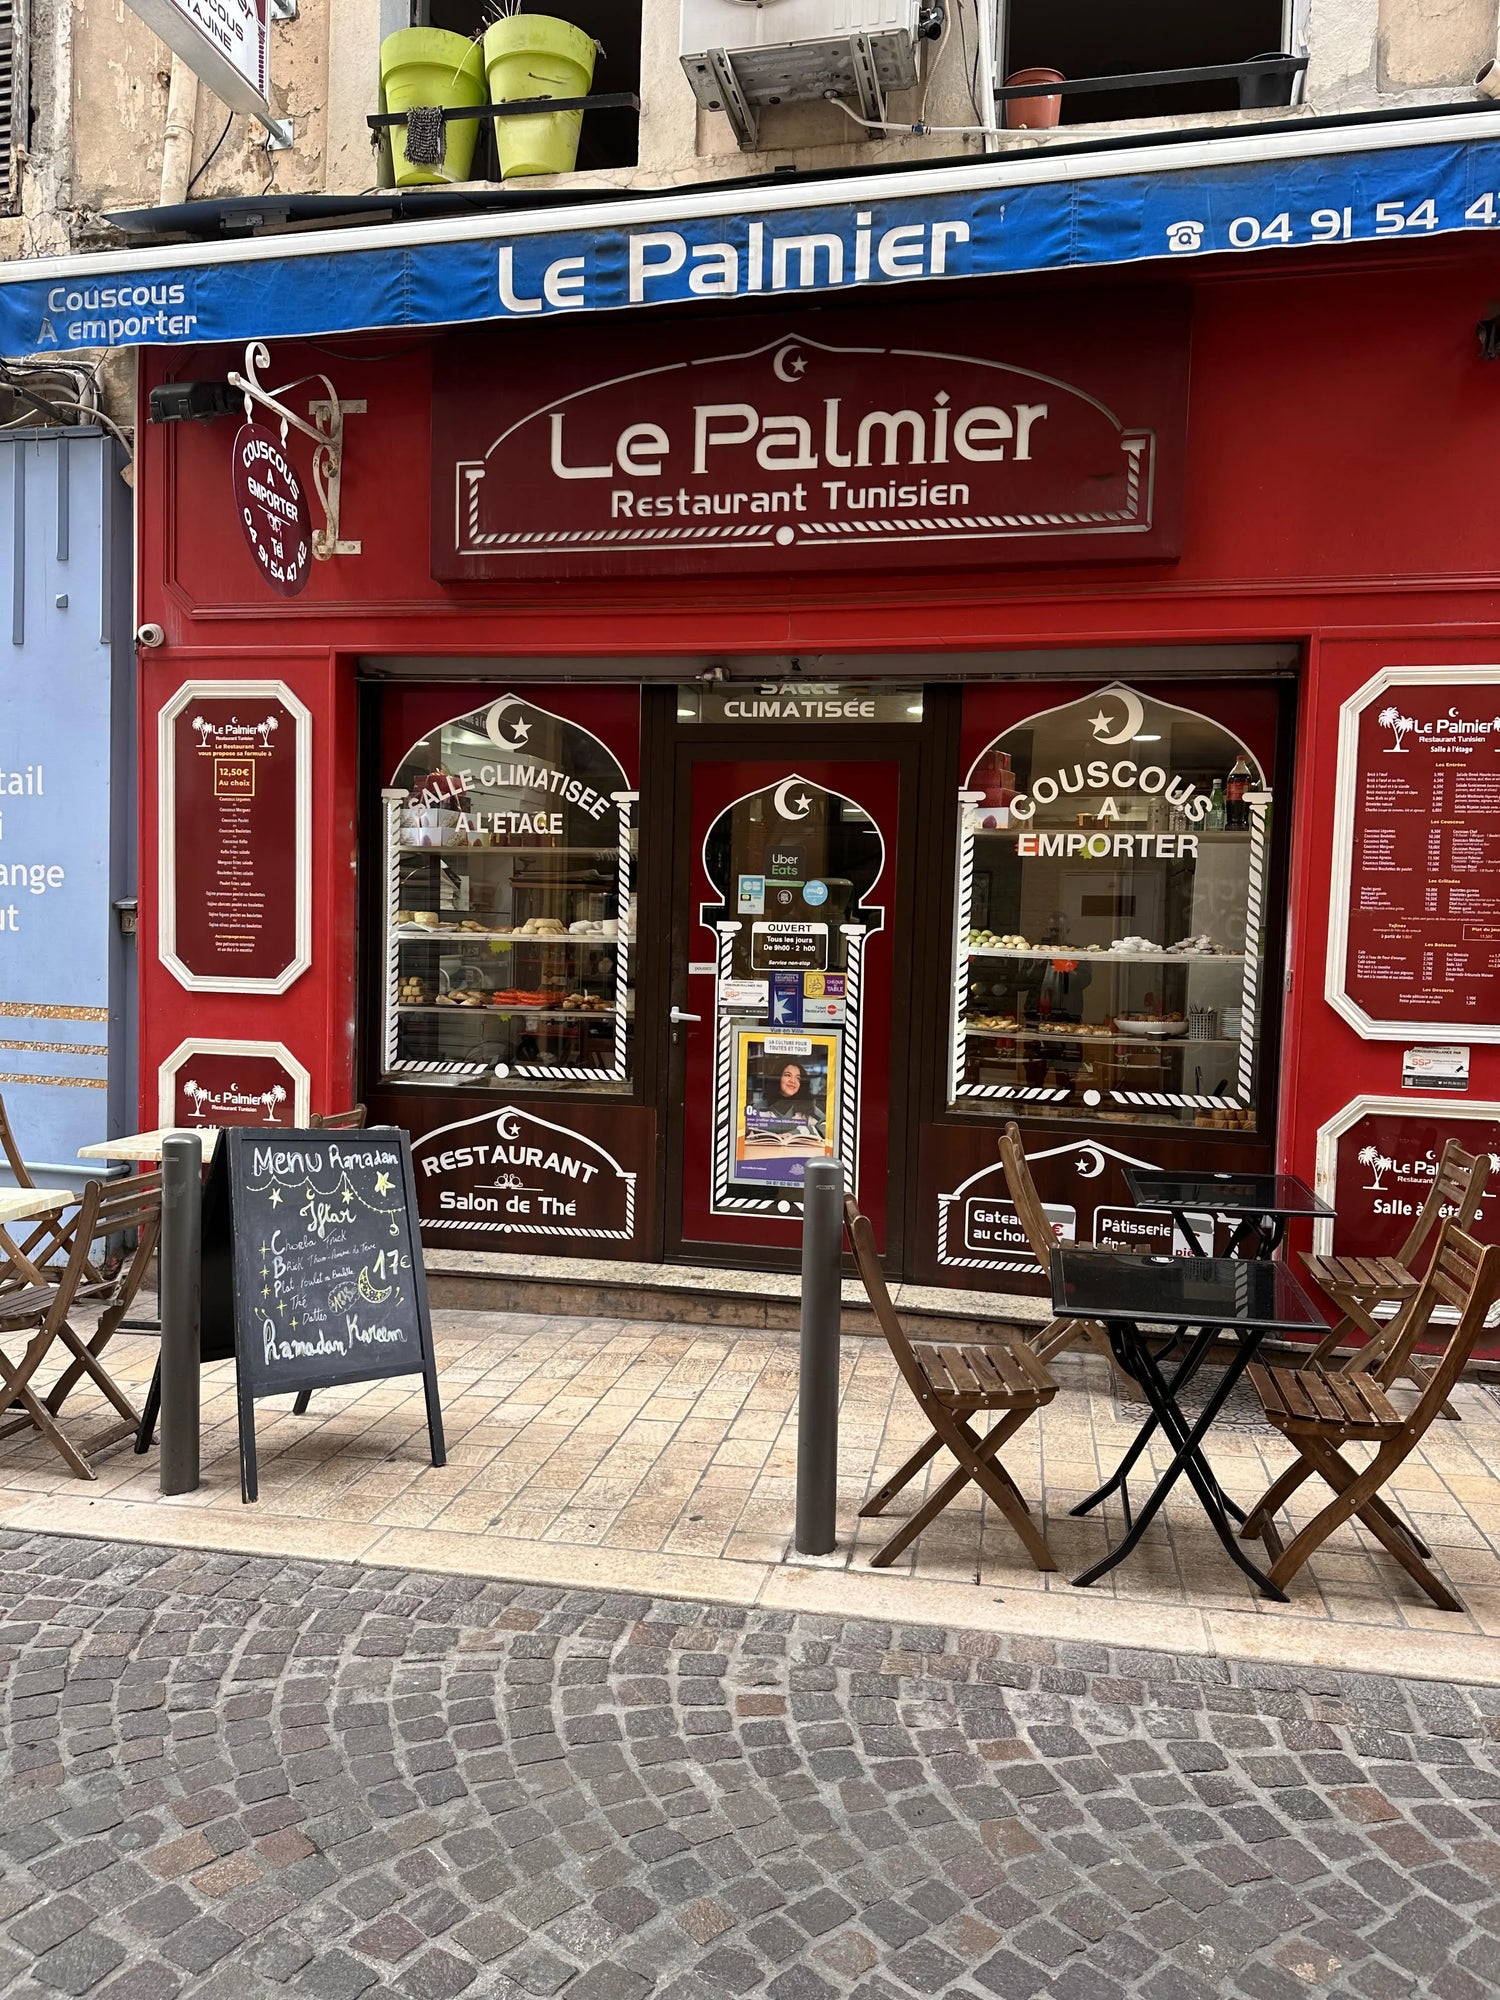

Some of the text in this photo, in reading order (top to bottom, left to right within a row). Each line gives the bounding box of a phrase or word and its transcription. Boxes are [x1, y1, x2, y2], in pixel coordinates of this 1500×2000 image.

[1228, 192, 1500, 248] 04 91 54 4
[499, 211, 971, 313] Le Palmier
[48, 284, 185, 312] Couscous
[68, 310, 197, 344] emporter
[549, 390, 1048, 480] Le Palmier
[242, 440, 300, 500] COUSCOUS
[266, 468, 275, 487] A
[247, 476, 299, 523] EMPORTER
[611, 479, 969, 518] Restaurant Tunisien
[724, 698, 875, 718] CLIMATISÉE
[213, 725, 258, 735] Le Palmier
[1414, 719, 1493, 733] Le Palmier
[219, 768, 250, 777] 12,50€
[408, 764, 611, 821] SALLE CLIMATISEE
[1009, 760, 1213, 822] COUSCOUS
[1097, 797, 1120, 820] A
[455, 812, 470, 833] A
[1018, 833, 1199, 858] EMPORTER
[772, 854, 798, 864] Uber
[772, 865, 798, 875] Eats
[768, 924, 812, 932] OUVERT
[795, 936, 813, 944] jours
[208, 1091, 261, 1105] Le Palmier
[254, 1144, 398, 1177] Menu Ramadan
[421, 1145, 599, 1183] RESTAURANT
[1392, 1161, 1410, 1174] Le
[440, 1191, 576, 1216] Salon de Thé
[1373, 1199, 1412, 1216] Salle
[974, 1229, 1030, 1243] au choi
[1102, 1218, 1171, 1236] Pâtisserie
[273, 1280, 294, 1298] Plat
[290, 1295, 307, 1310] Thé
[263, 1313, 407, 1365] Ramadan Kareem
